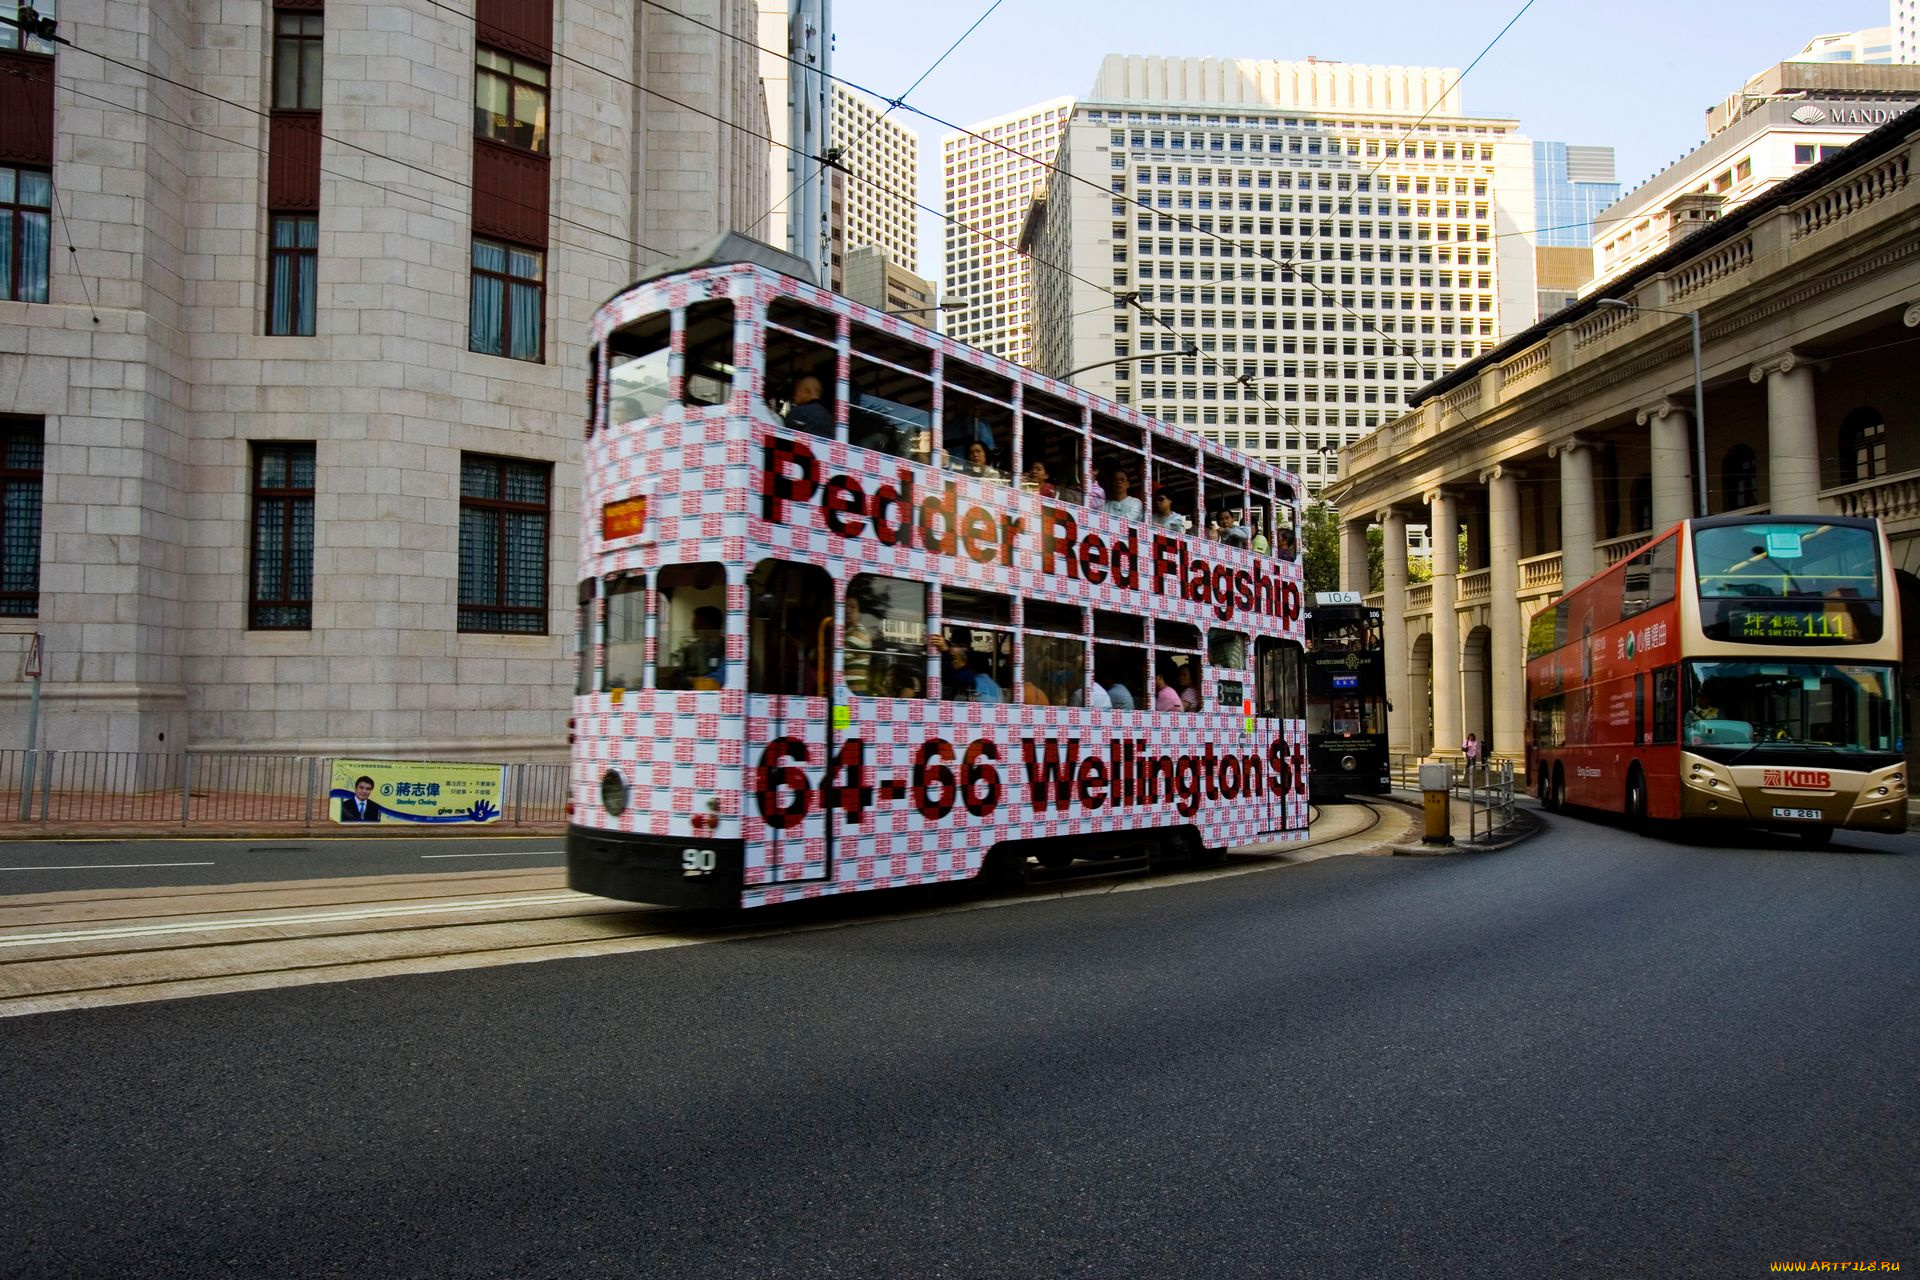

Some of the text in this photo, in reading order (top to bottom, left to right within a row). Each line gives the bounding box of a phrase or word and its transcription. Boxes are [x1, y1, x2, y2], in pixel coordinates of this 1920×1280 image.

[763, 435, 1300, 626] Pedder Red Flagship
[1328, 592, 1352, 603] 106
[1783, 629, 1803, 637] CITY
[1803, 612, 1847, 637] 111
[756, 737, 1002, 830] 64-66
[1022, 737, 1264, 818] Wellington
[1268, 738, 1306, 798] St
[1784, 770, 1832, 789] KMB
[395, 782, 440, 797] 蔣志偉
[438, 807, 453, 815] give
[1775, 810, 1820, 819] LG 261
[682, 849, 716, 871] 90
